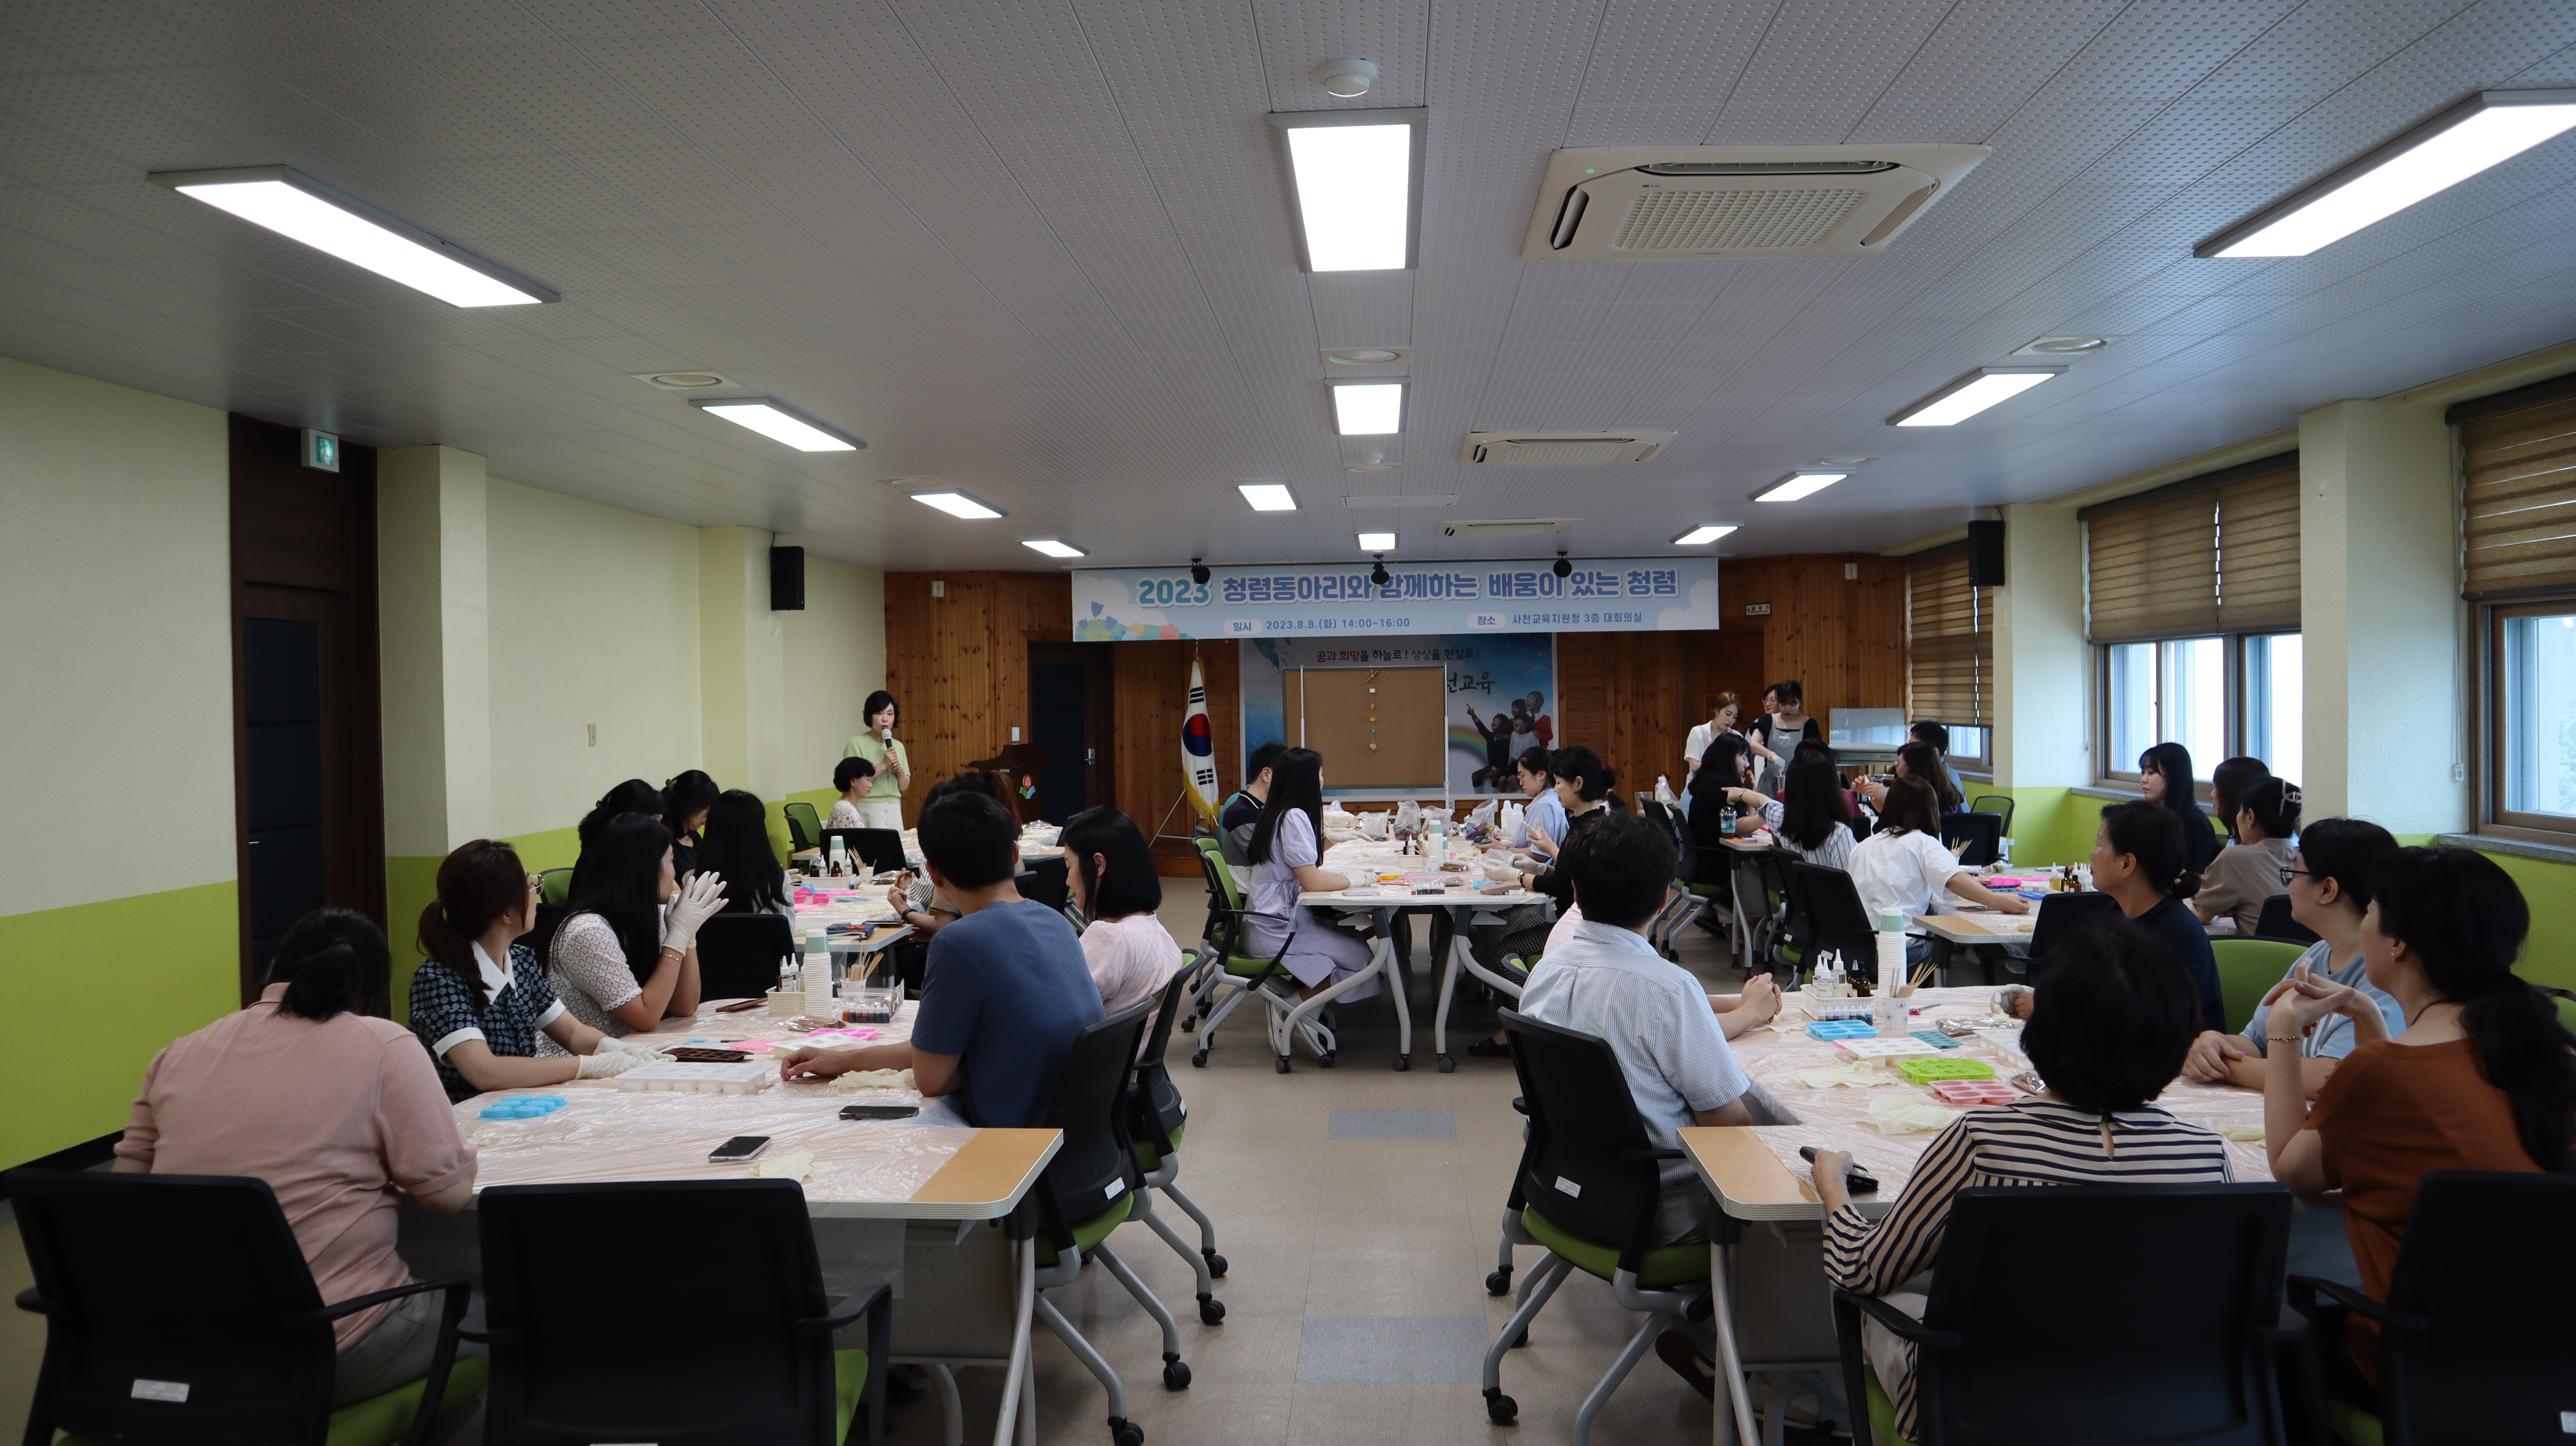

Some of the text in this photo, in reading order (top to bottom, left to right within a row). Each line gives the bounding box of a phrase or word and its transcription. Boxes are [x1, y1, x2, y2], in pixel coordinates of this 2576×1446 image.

[1139, 569, 1677, 604] 2023 청렴동아리와 함께하는 배움이 있는 청렴
[1233, 618, 1410, 632] 일시 2023.8.8.(화) 14:00~16:00
[1477, 612, 1642, 626] 장소 사천교육지원청 3층 대회의실
[1316, 650, 1337, 663] 꿈과
[1339, 650, 1370, 662] 희망을
[1411, 648, 1441, 661] 상상을
